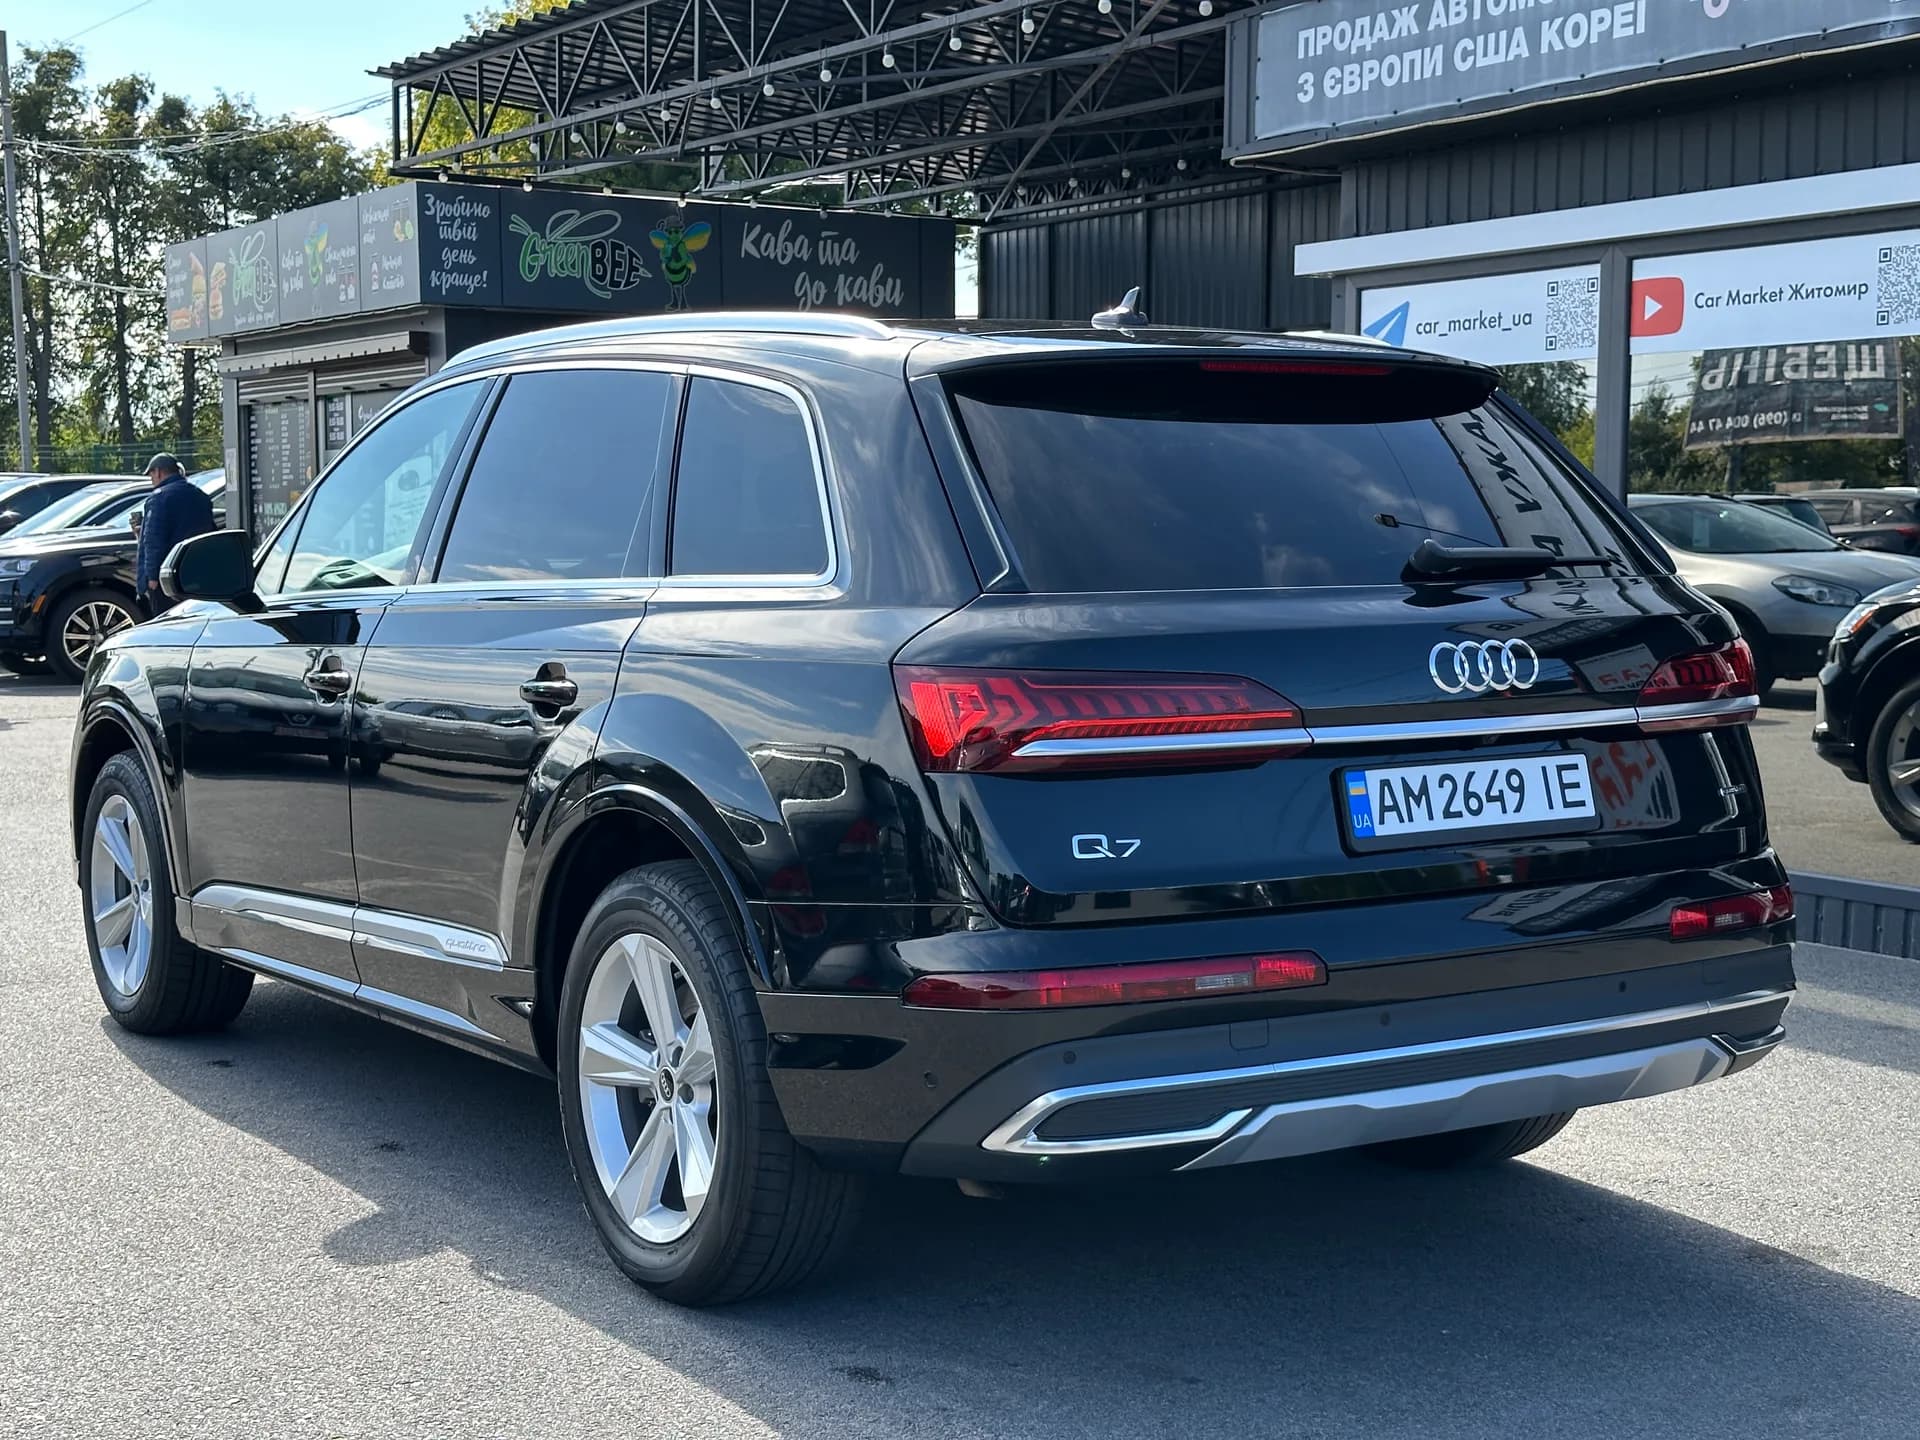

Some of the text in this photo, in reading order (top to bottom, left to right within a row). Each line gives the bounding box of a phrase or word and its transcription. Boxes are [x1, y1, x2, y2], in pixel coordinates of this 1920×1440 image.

[1298, 0, 1553, 59] ПРОДАЖ АВТО
[1297, 72, 1314, 103] З
[1323, 45, 1443, 98] ЄВРОПИ
[1453, 26, 1530, 72] США
[424, 193, 491, 224] Зробимо
[439, 218, 478, 241] твій
[741, 219, 860, 266] Кава та
[441, 247, 476, 270] день
[429, 270, 488, 295] краще!
[794, 263, 904, 312] до кави
[1694, 282, 1869, 309] Car Market Житомир
[1415, 309, 1532, 337] car_market_ua
[1541, 763, 1587, 810] IE
[1353, 813, 1372, 830] UA
[1071, 834, 1141, 859] Q7
[445, 937, 487, 952] quattro
